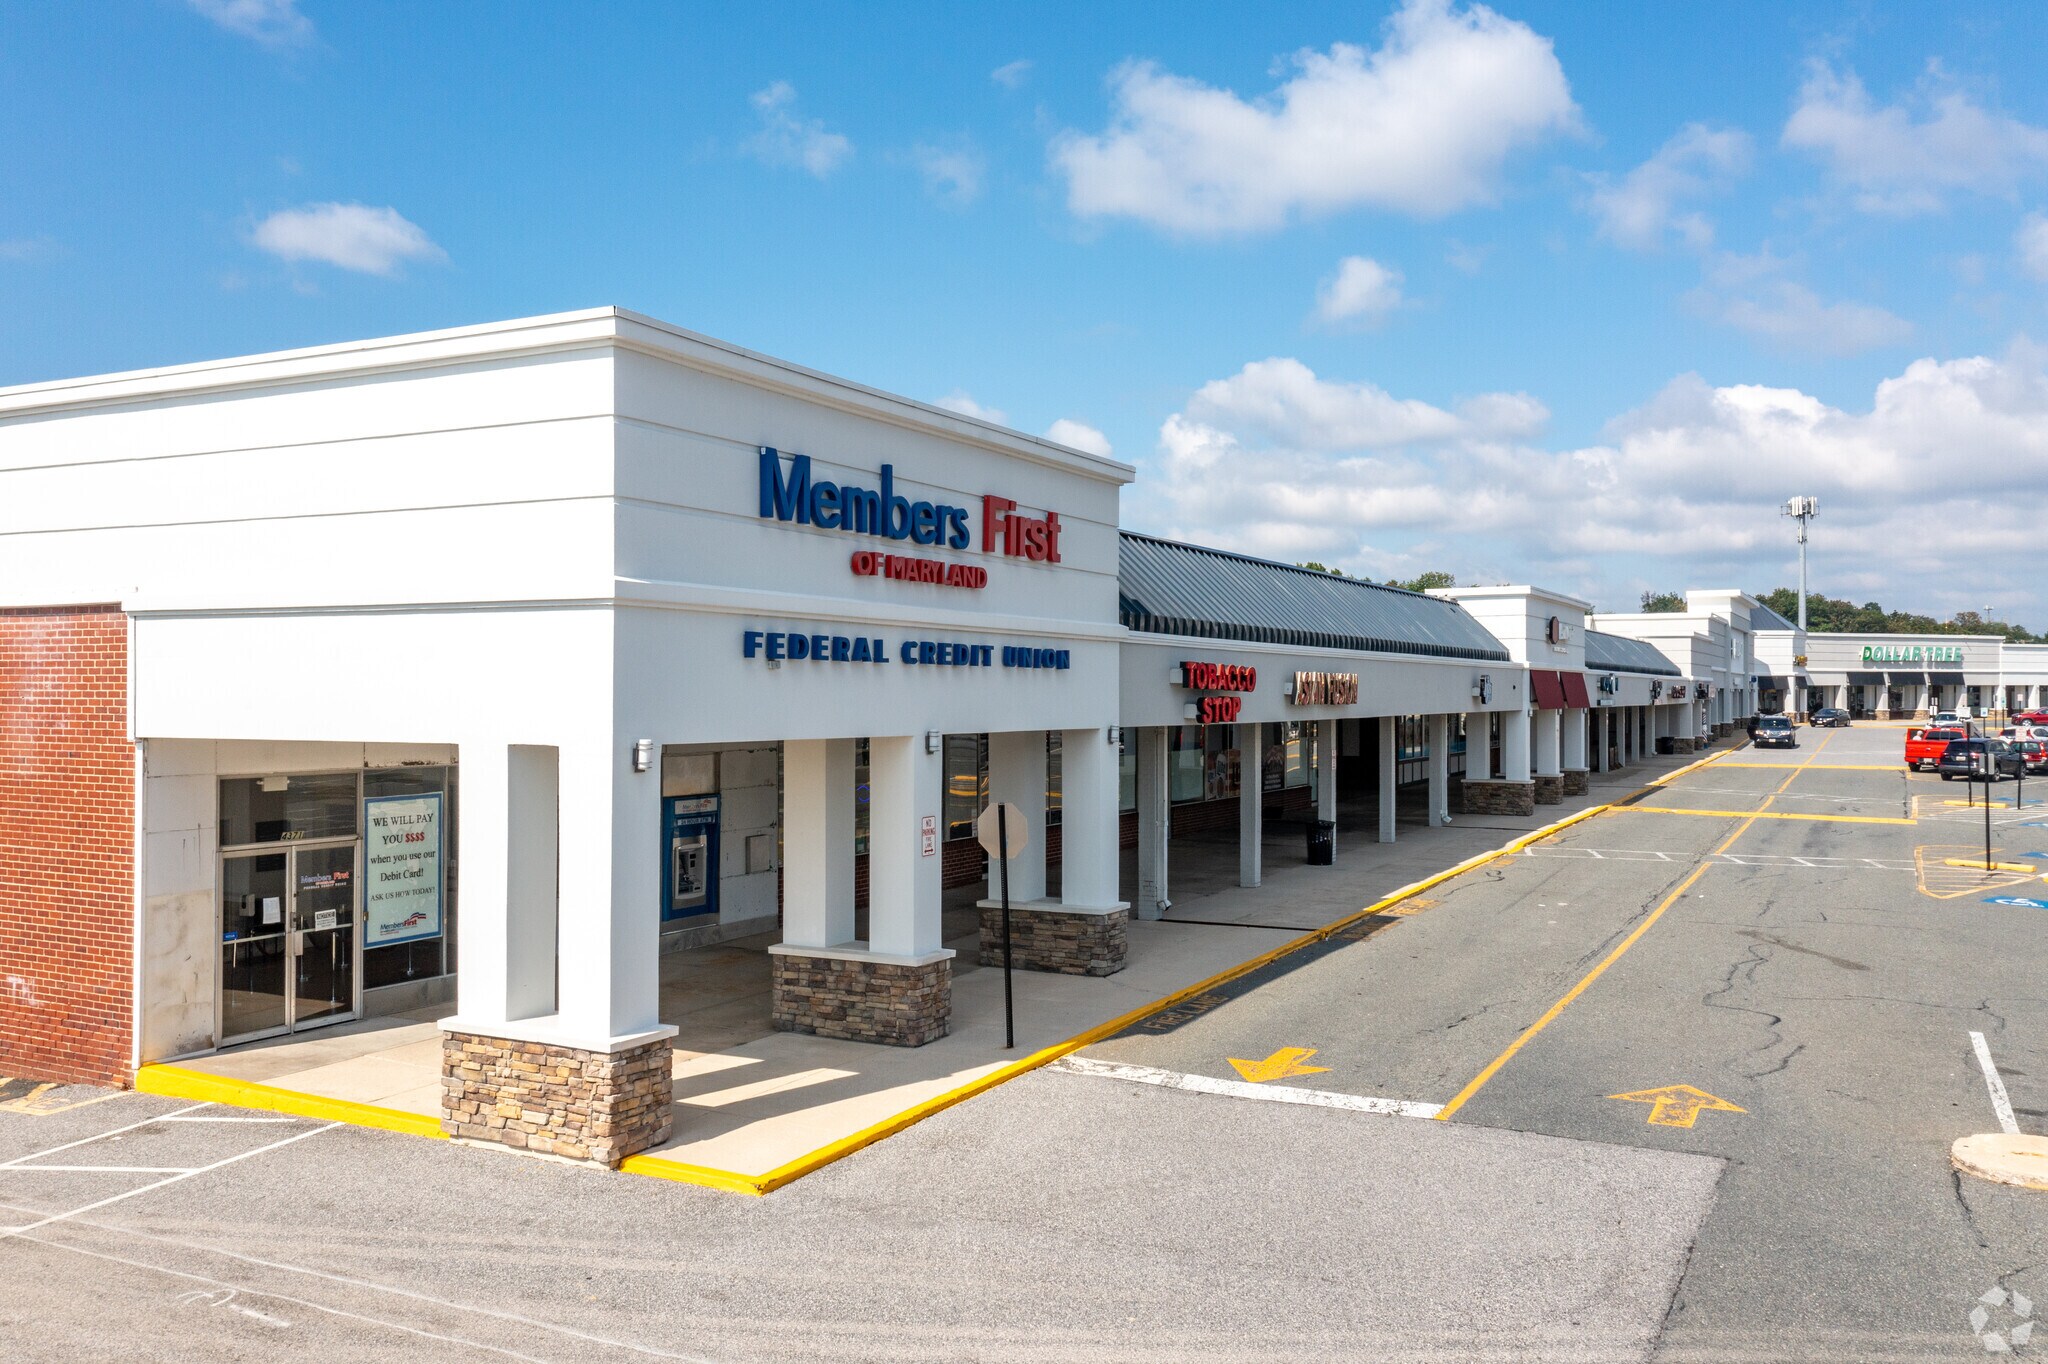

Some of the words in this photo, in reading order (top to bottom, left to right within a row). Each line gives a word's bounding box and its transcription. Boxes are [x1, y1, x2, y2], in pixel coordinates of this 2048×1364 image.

[759, 446, 970, 550] Members
[982, 494, 1062, 563] First
[852, 551, 884, 576] OF
[885, 554, 988, 589] MARYLAND
[743, 630, 889, 663] FEDERAL
[901, 640, 995, 667] CREDIT
[1002, 645, 1070, 669] UNION
[1861, 645, 1922, 662] DOLLAR
[1924, 646, 1962, 662] TREE
[1180, 661, 1257, 692] TOBACCO
[1196, 696, 1242, 724] STOP
[373, 817, 388, 827] WE
[391, 815, 414, 825] WILL
[416, 813, 434, 824] PAY
[281, 831, 303, 840] 4371
[382, 834, 403, 845] YOU
[405, 831, 425, 843] $$$$
[370, 855, 391, 864] when
[393, 854, 407, 864] you
[380, 871, 401, 882] Debit
[403, 868, 424, 878] Card!
[370, 893, 384, 901] ASK
[395, 890, 410, 898] HOW
[412, 886, 435, 895] TODAY!
